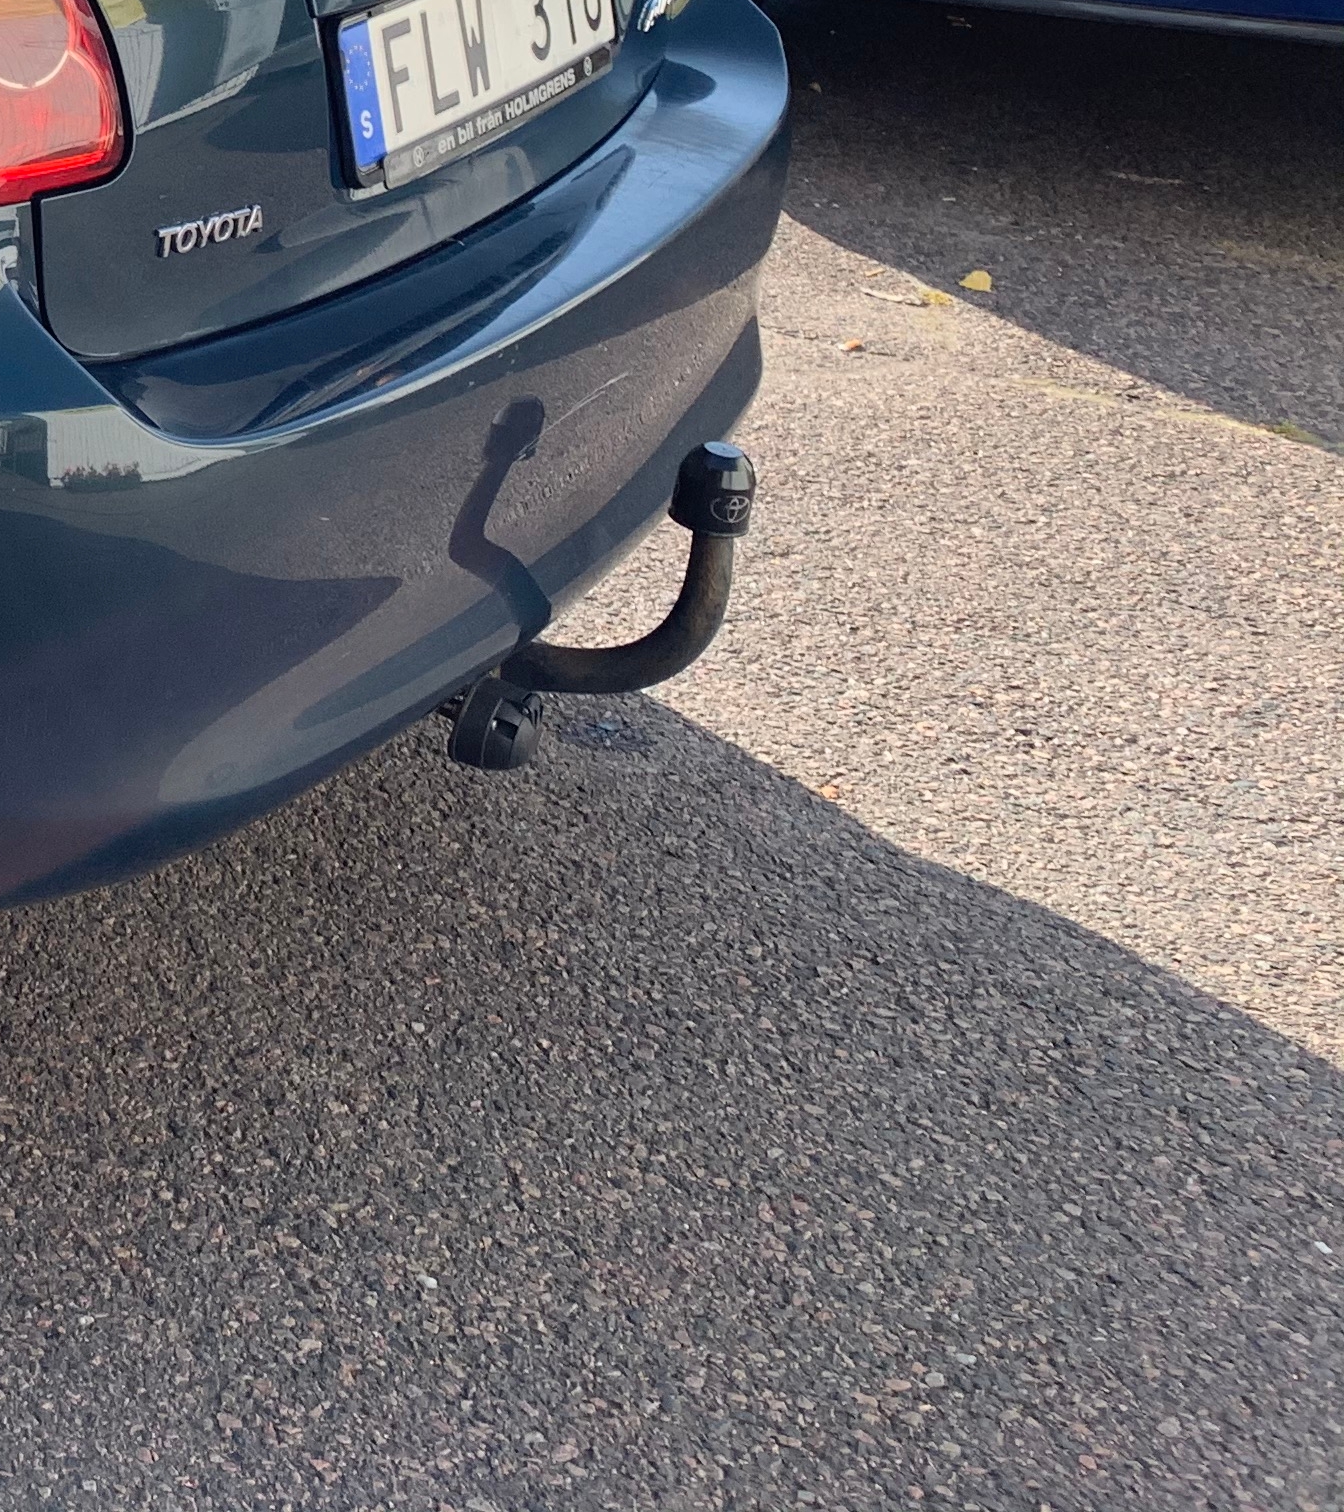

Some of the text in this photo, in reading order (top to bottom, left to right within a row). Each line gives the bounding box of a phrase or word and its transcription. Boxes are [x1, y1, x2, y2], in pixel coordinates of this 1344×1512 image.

[360, 109, 374, 139] S
[437, 67, 576, 154] en bil från HOLMGRENS
[154, 204, 264, 258] TOYOTA
